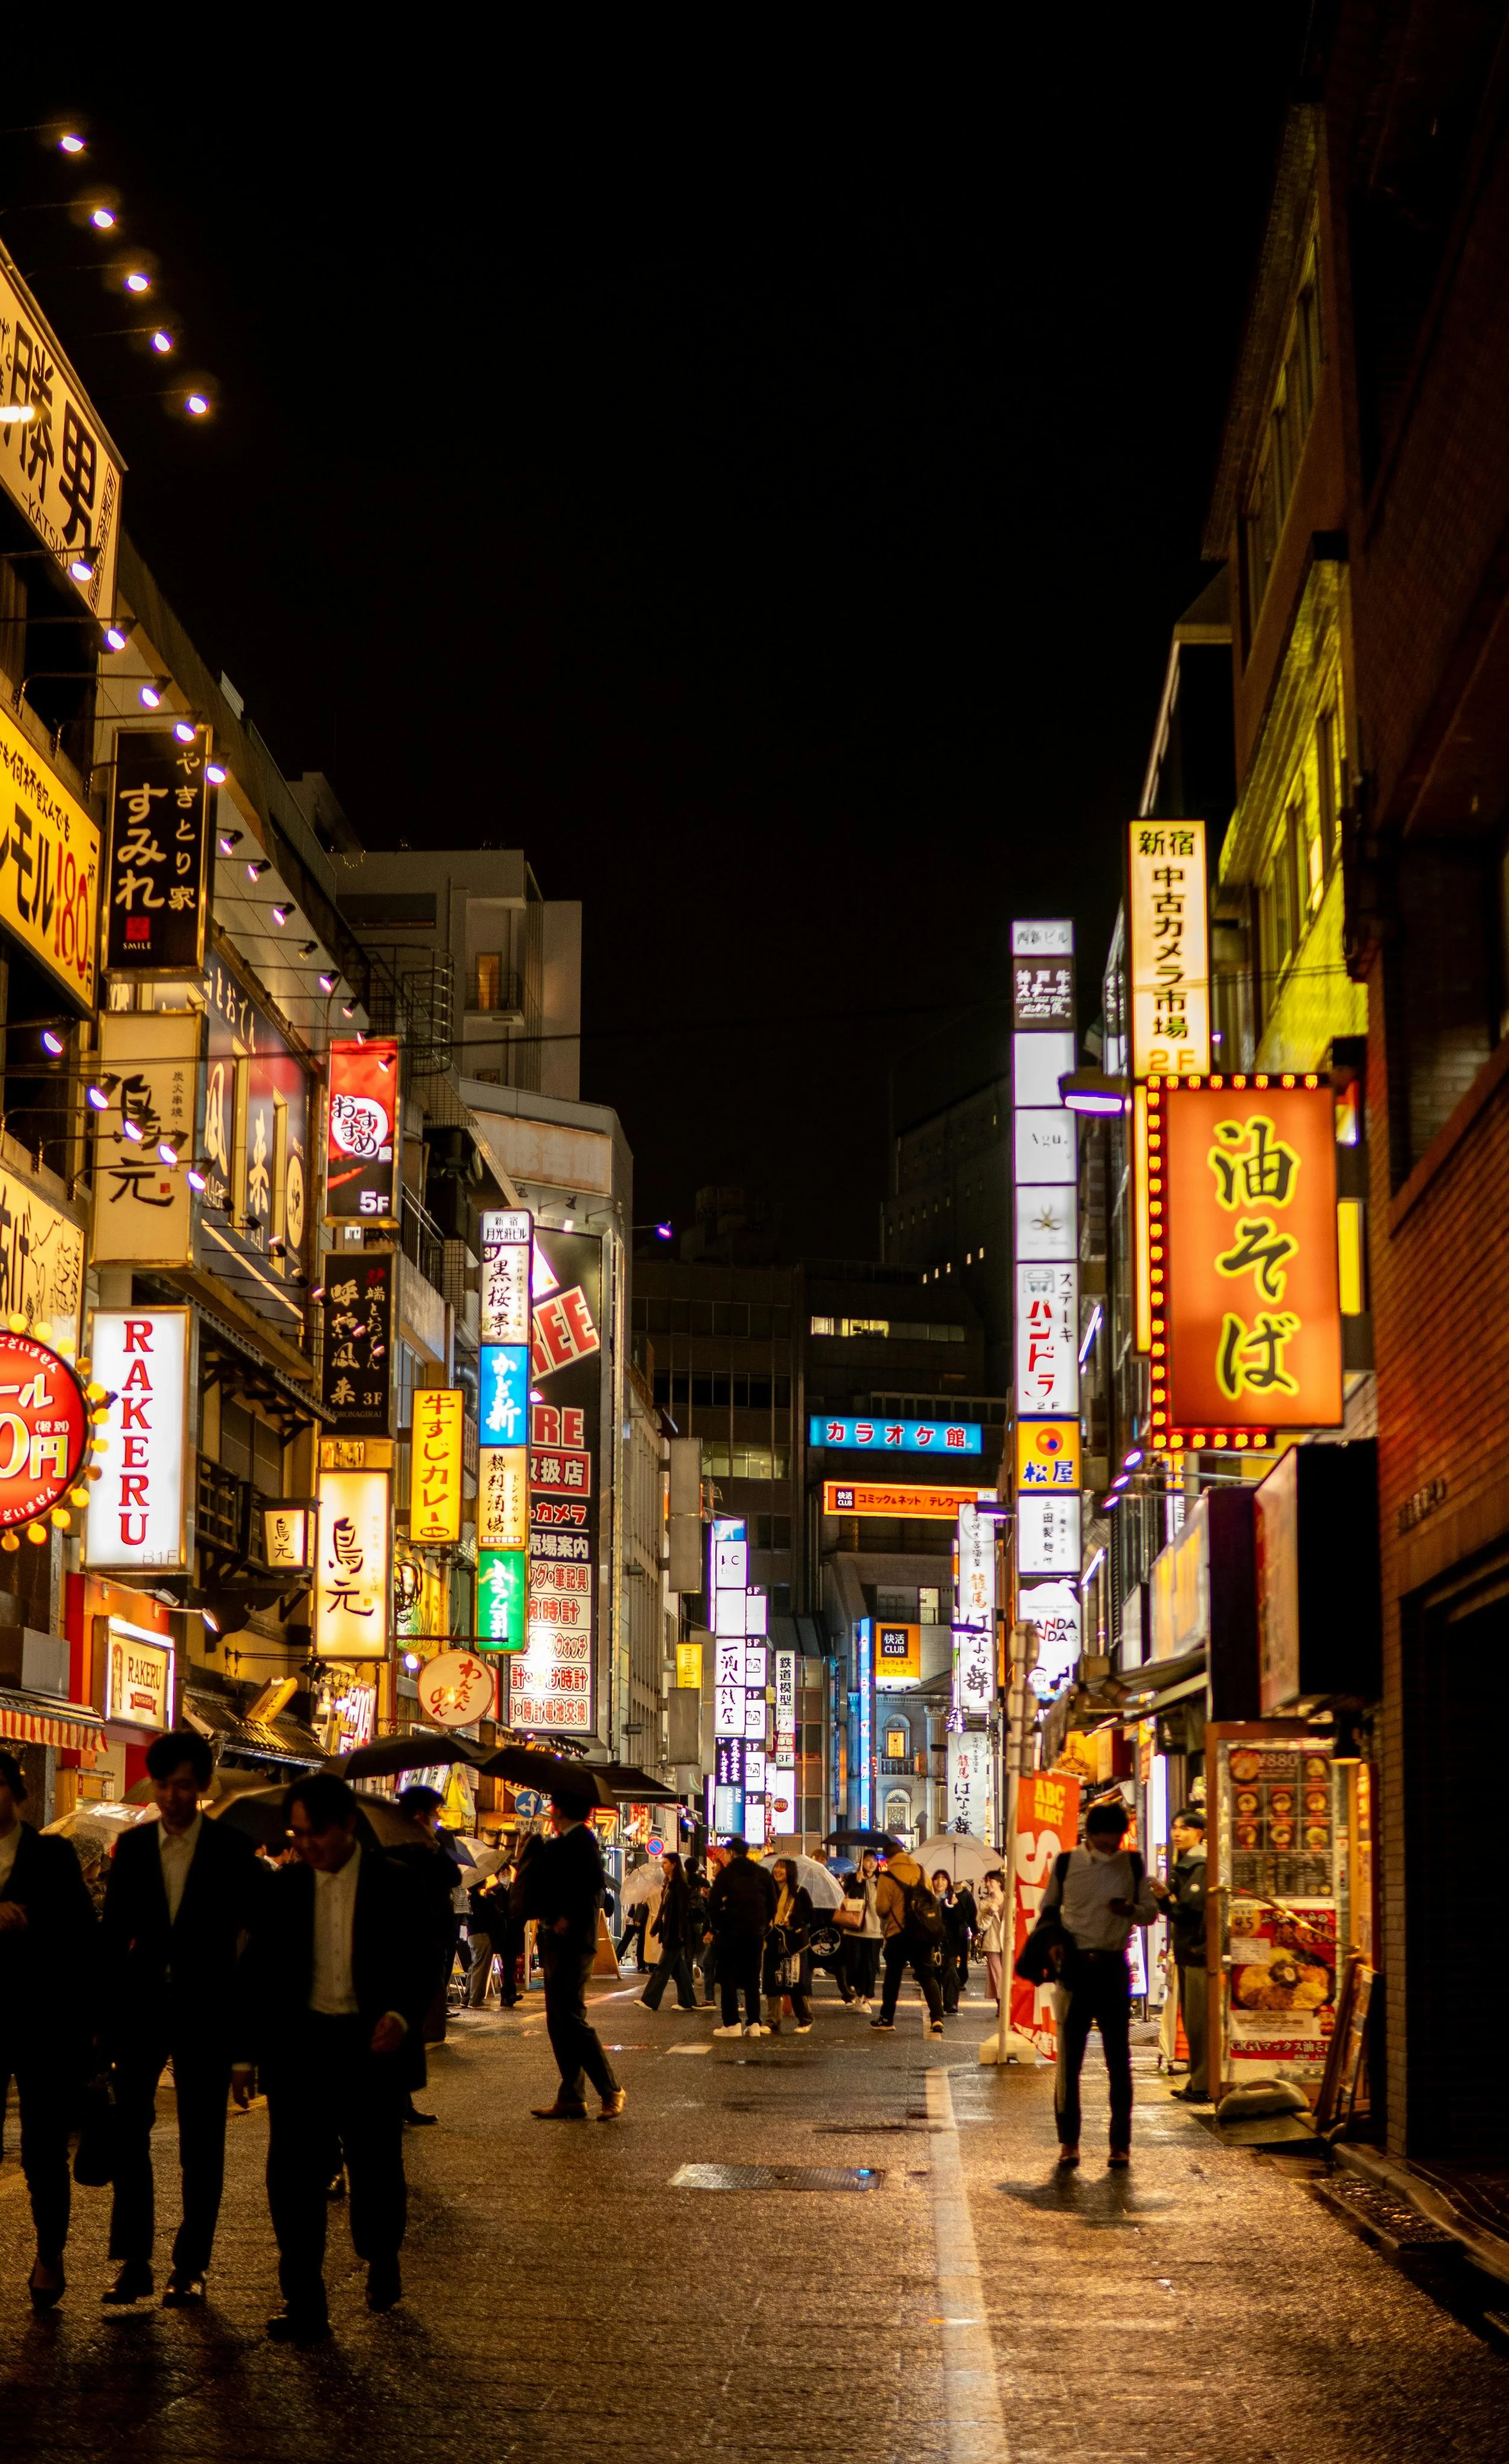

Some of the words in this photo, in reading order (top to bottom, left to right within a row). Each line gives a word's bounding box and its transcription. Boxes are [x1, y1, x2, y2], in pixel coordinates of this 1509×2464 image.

[0, 742, 71, 843] も何杯飲んでも
[168, 752, 200, 911] やきとり家
[1138, 829, 1195, 856] 新宿
[115, 783, 168, 911] すみれ
[54, 839, 89, 980] 180
[123, 941, 152, 950] SMILE
[1152, 866, 1189, 1039] 中古カメラ市場
[1016, 969, 1071, 985] 神戸牛
[1016, 984, 1071, 998] ステーキ
[1149, 1048, 1195, 1072] 2F
[360, 1191, 389, 1214] 5F
[495, 1216, 518, 1226] 新宿
[483, 1247, 497, 1259] 3F
[1209, 1116, 1300, 1399] 油そば
[488, 1259, 512, 1337] 黒桜亭
[1058, 1273, 1074, 1343] ステーキ
[1023, 1299, 1055, 1398] パンドラ
[363, 1392, 383, 1405] 3F
[1037, 1401, 1061, 1410] 2F
[118, 1320, 155, 1546] RAKERU
[827, 1421, 966, 1448] カラオケ館
[421, 1393, 455, 1523] 牛すじカレー
[1022, 1460, 1074, 1483] 松屋
[487, 1453, 506, 1533] 熱烈酒場
[511, 1474, 520, 1523] ドンちゃん
[837, 1491, 853, 1500] 快活
[275, 1517, 295, 1559] 鳥元
[529, 1532, 589, 1559] 売場案内
[142, 1549, 177, 1565] B1F
[325, 1517, 375, 1617] 鳥元
[746, 1587, 760, 1595] 6F
[884, 1633, 905, 1644] 快活
[1033, 1617, 1077, 1634] ANDA
[746, 1638, 761, 1647] 5F
[884, 1645, 905, 1654] CLUB
[963, 1614, 994, 1699] はなの舞
[128, 1656, 162, 1690] RAKERU
[779, 1657, 792, 1706] 鉄道模型
[746, 1690, 761, 1699] 4F
[746, 1743, 760, 1751] 3F
[745, 1795, 759, 1804] 2F
[1034, 1778, 1065, 1809] ABC
[953, 1781, 972, 1835] はなの舞
[1034, 1802, 1064, 1826] MART
